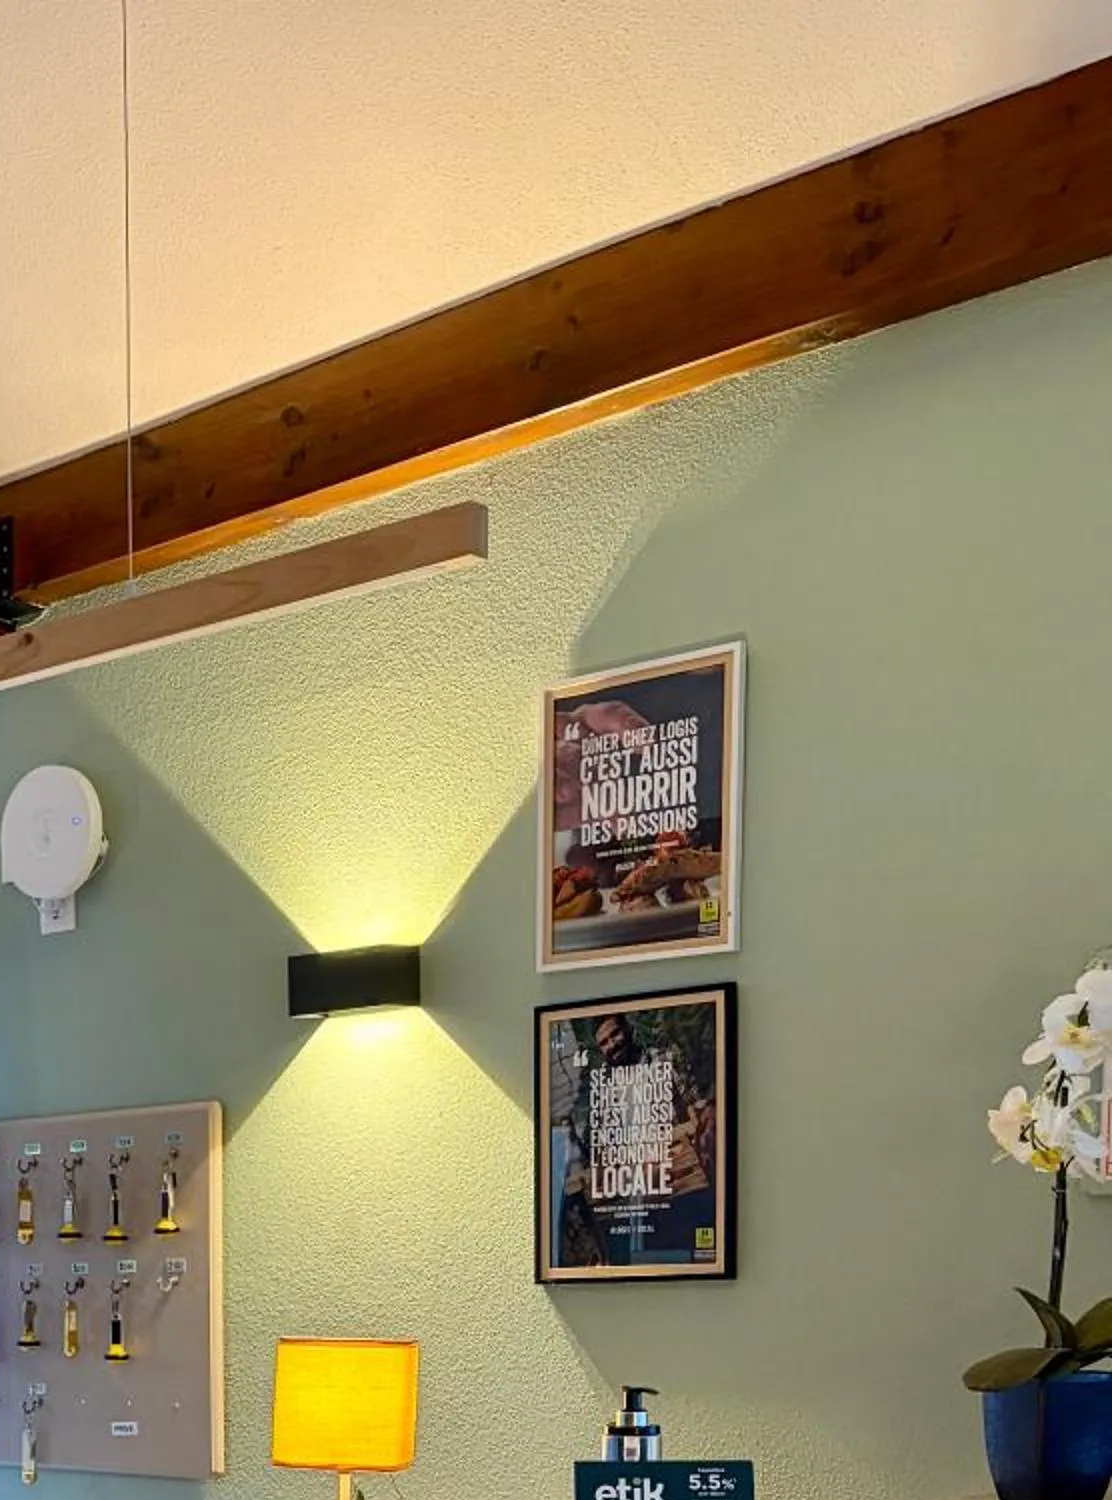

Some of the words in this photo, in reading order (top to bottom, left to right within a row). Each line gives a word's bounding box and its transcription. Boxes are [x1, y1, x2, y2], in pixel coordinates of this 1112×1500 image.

[622, 725, 657, 748] CHEZ
[659, 716, 698, 741] LOGIS
[580, 748, 634, 784] C'EST
[640, 736, 698, 773] AUSSI
[581, 766, 697, 821] NOURRIR
[581, 820, 612, 847] DES
[616, 805, 697, 841] PASSIONS
[590, 1061, 672, 1088] SÉJOURNER
[590, 1085, 627, 1109] CHEZ
[633, 1081, 673, 1105] NOUS
[590, 1106, 628, 1128] C'EST
[632, 1101, 673, 1125] AUSSI
[590, 1123, 673, 1146] ENCOURAGER
[591, 1163, 673, 1199] LOCALE
